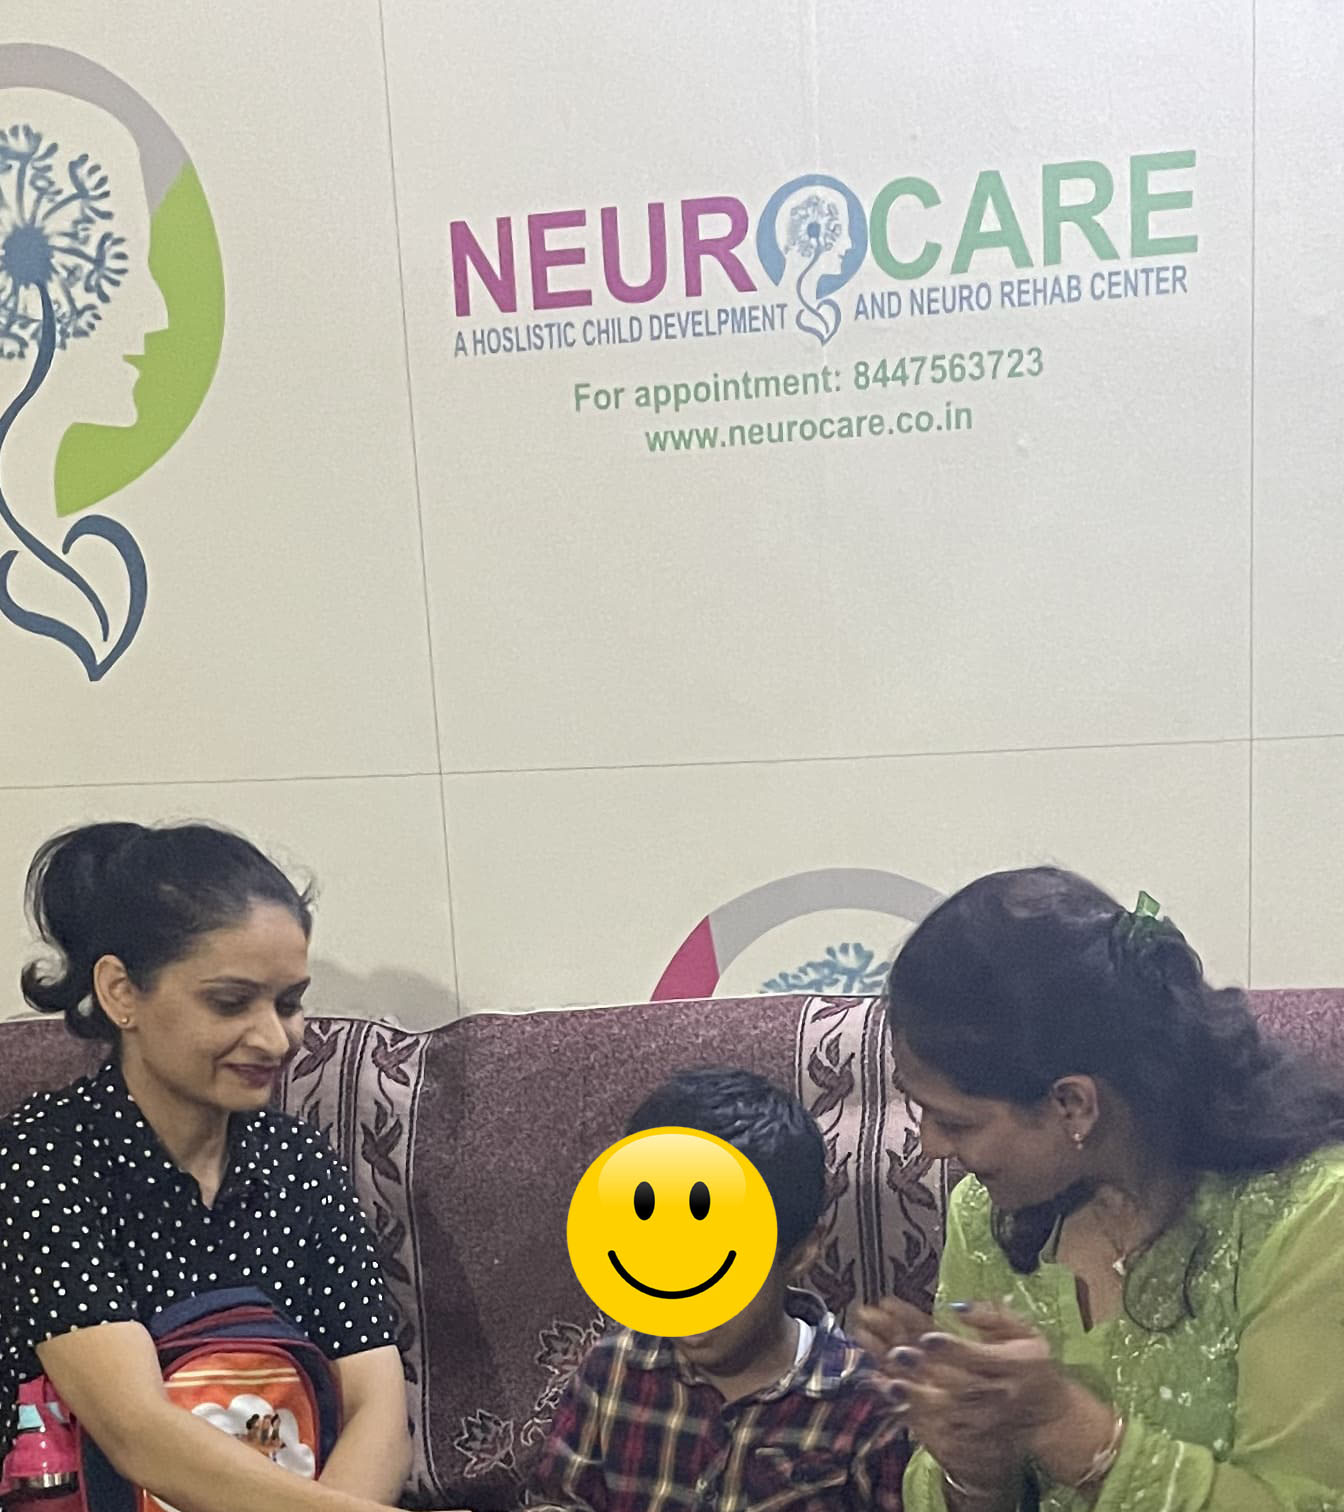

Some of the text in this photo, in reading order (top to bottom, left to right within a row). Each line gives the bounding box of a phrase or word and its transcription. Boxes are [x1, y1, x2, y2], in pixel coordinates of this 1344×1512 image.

[454, 265, 1188, 357] A HOSLISTIC CHILD DEVELPMENT AND NEURO REHAB CENTER
[574, 347, 1045, 414] For appointment: 8447563723
[645, 402, 974, 452] www.neurocare.co.in
